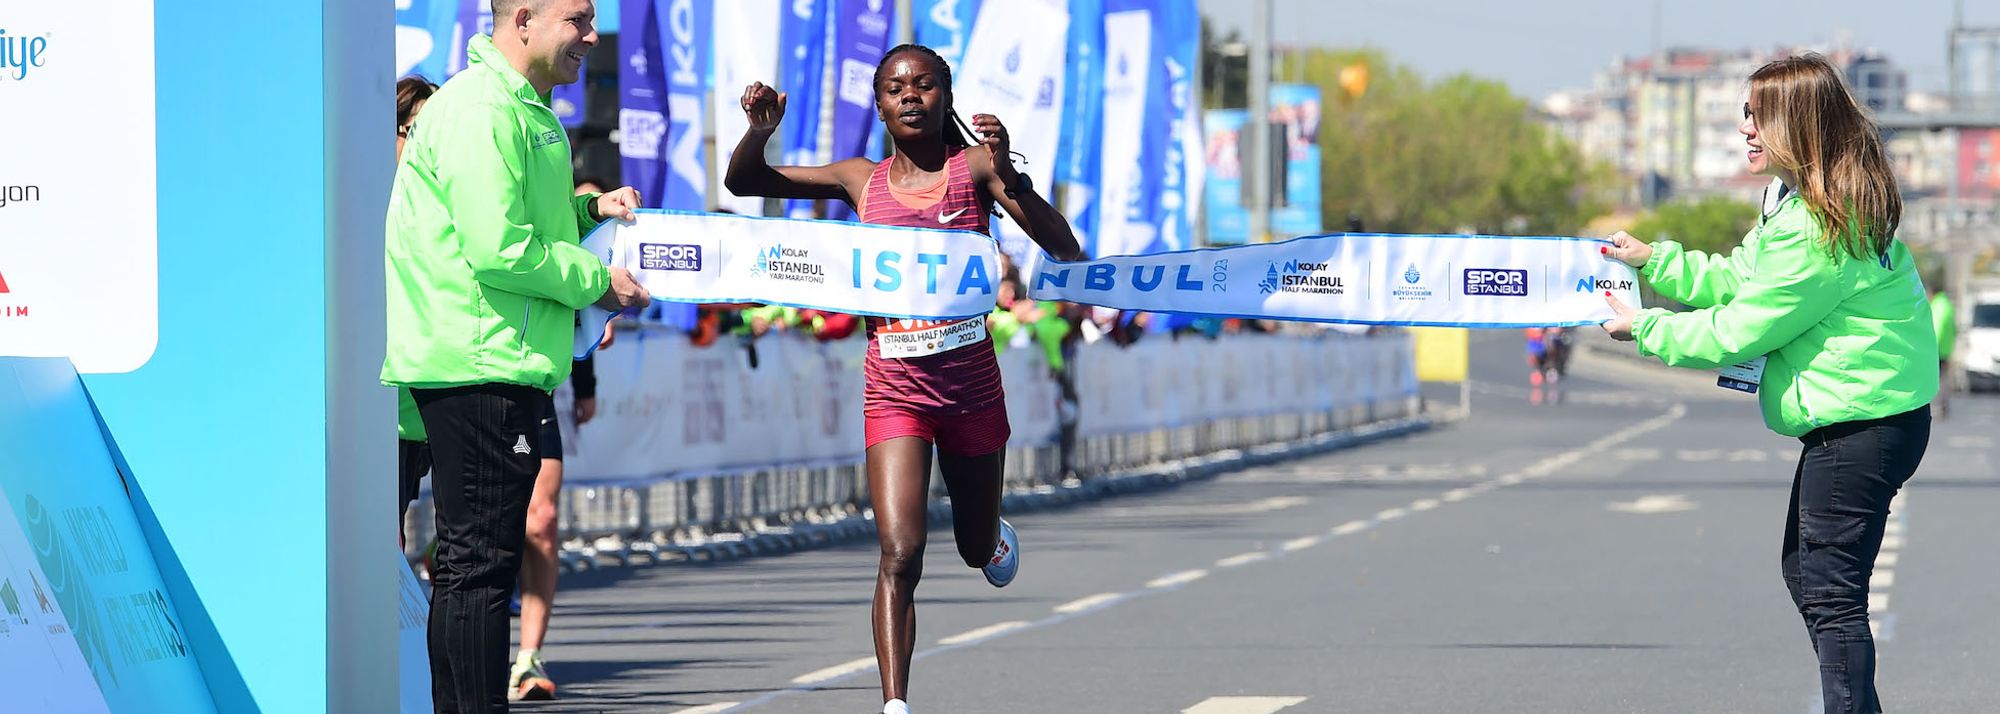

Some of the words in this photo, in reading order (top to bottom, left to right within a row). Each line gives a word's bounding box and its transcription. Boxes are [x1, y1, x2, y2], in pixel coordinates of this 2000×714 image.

[642, 244, 698, 262] SPOR
[769, 272, 785, 280] YARI
[785, 273, 825, 285] MARATONU
[1212, 258, 1229, 293] 2023
[1467, 270, 1524, 285] SPOR
[1281, 286, 1301, 294] HALF
[1301, 286, 1344, 296] MARATHON
[884, 334, 918, 344] ISTANBUL
[917, 330, 939, 342] HALF
[939, 319, 983, 337] MARATHON
[957, 331, 977, 344] 2023
